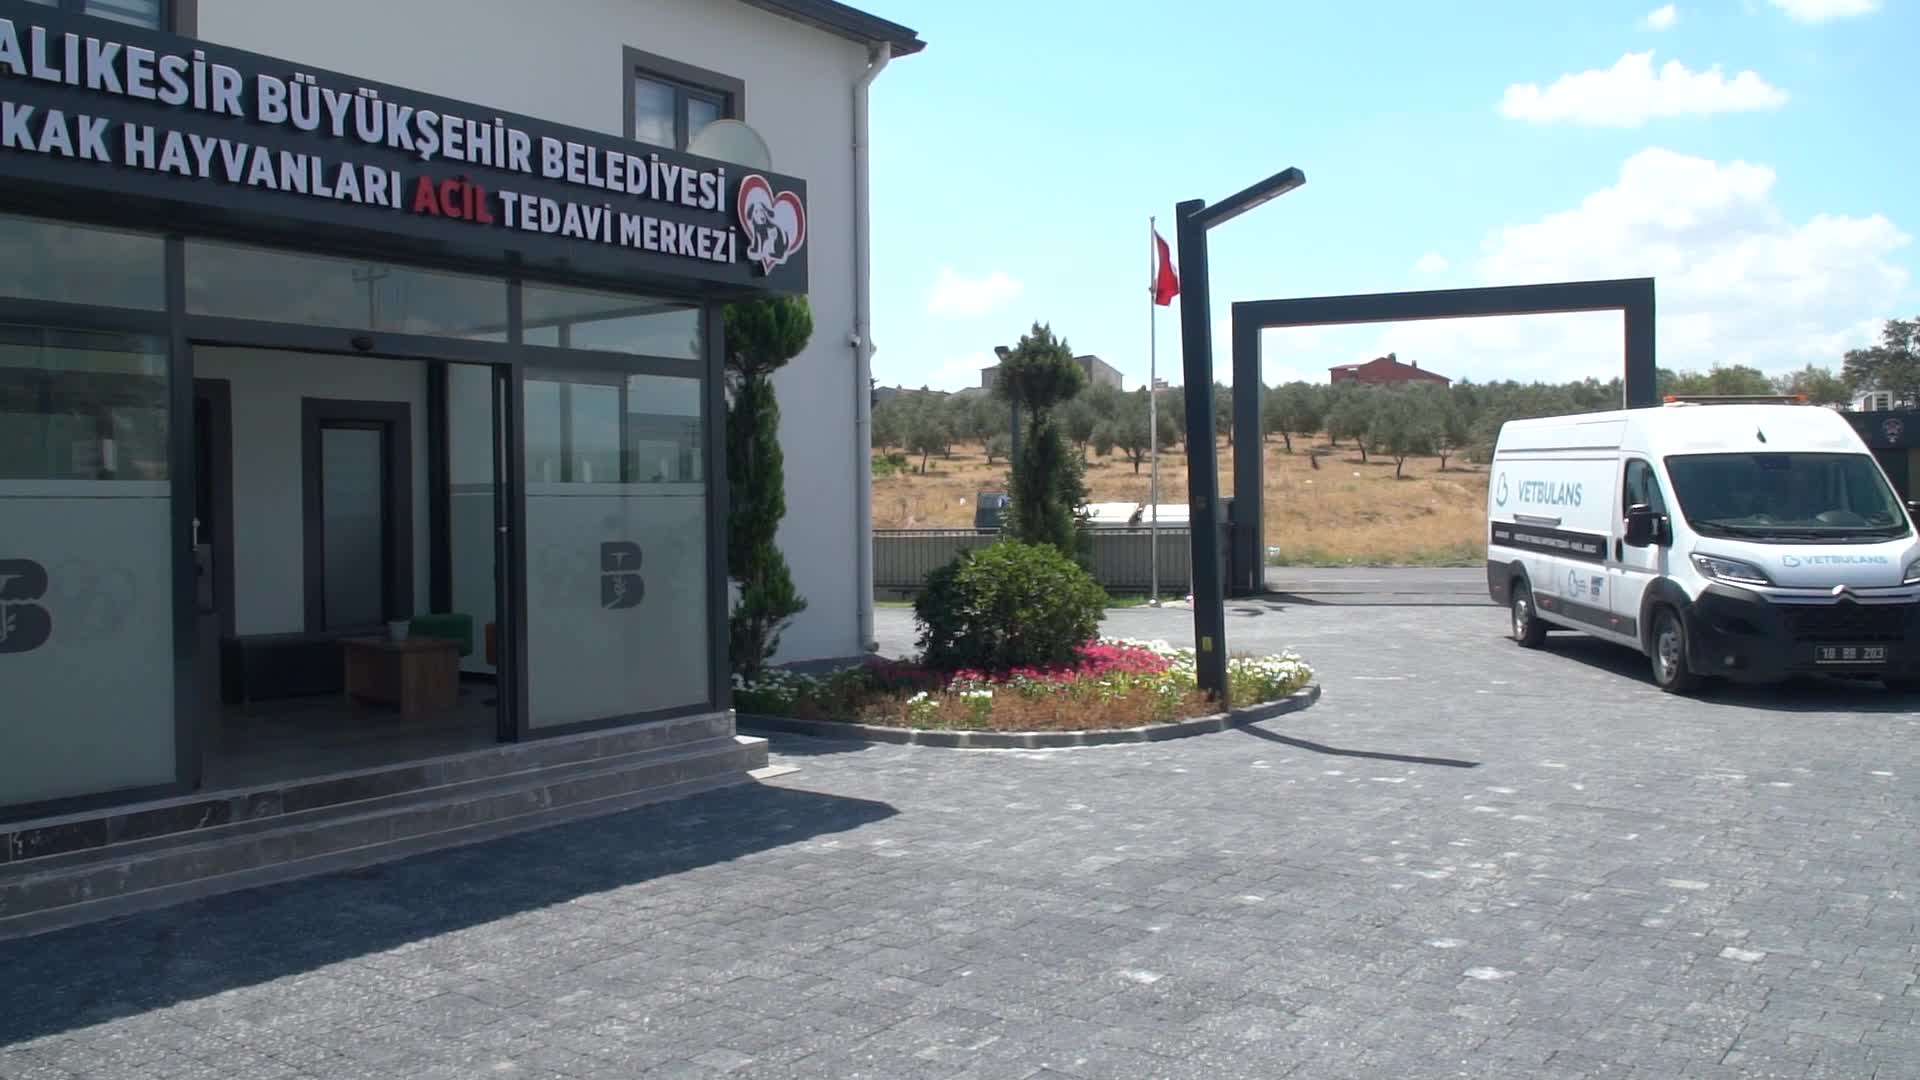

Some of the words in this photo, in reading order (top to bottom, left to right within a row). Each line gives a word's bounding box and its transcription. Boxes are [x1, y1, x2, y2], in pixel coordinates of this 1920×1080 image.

[2, 101, 111, 162] KAK
[124, 122, 402, 208] HAYVANLARI
[413, 172, 494, 224] ACİL
[499, 190, 612, 243] TEDAVİ
[620, 212, 736, 265] MERKEZİ
[257, 72, 532, 173] BÜYÜKŞEHİR
[542, 136, 726, 212] BELEDİYESİ
[1518, 480, 1583, 506] VETBULANS
[1804, 554, 1888, 565] VETBULANS
